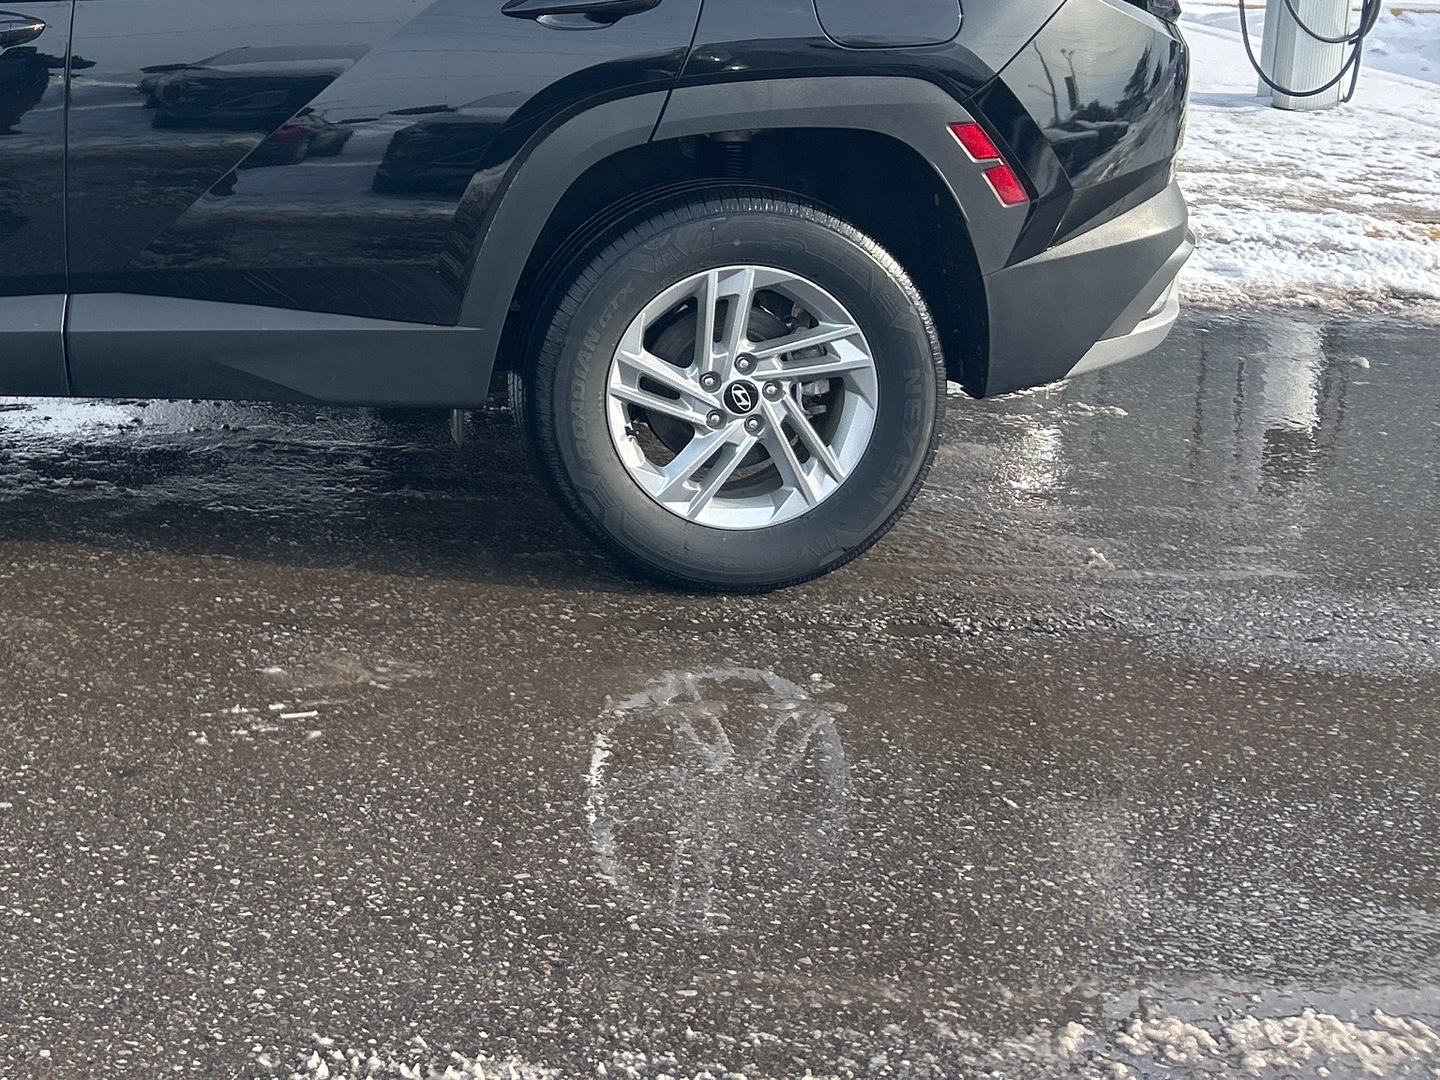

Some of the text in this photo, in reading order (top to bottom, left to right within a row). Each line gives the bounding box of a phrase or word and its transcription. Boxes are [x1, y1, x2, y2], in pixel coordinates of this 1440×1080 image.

[570, 281, 636, 459] ROADIAN GTX
[870, 368, 922, 506] NEXEN
